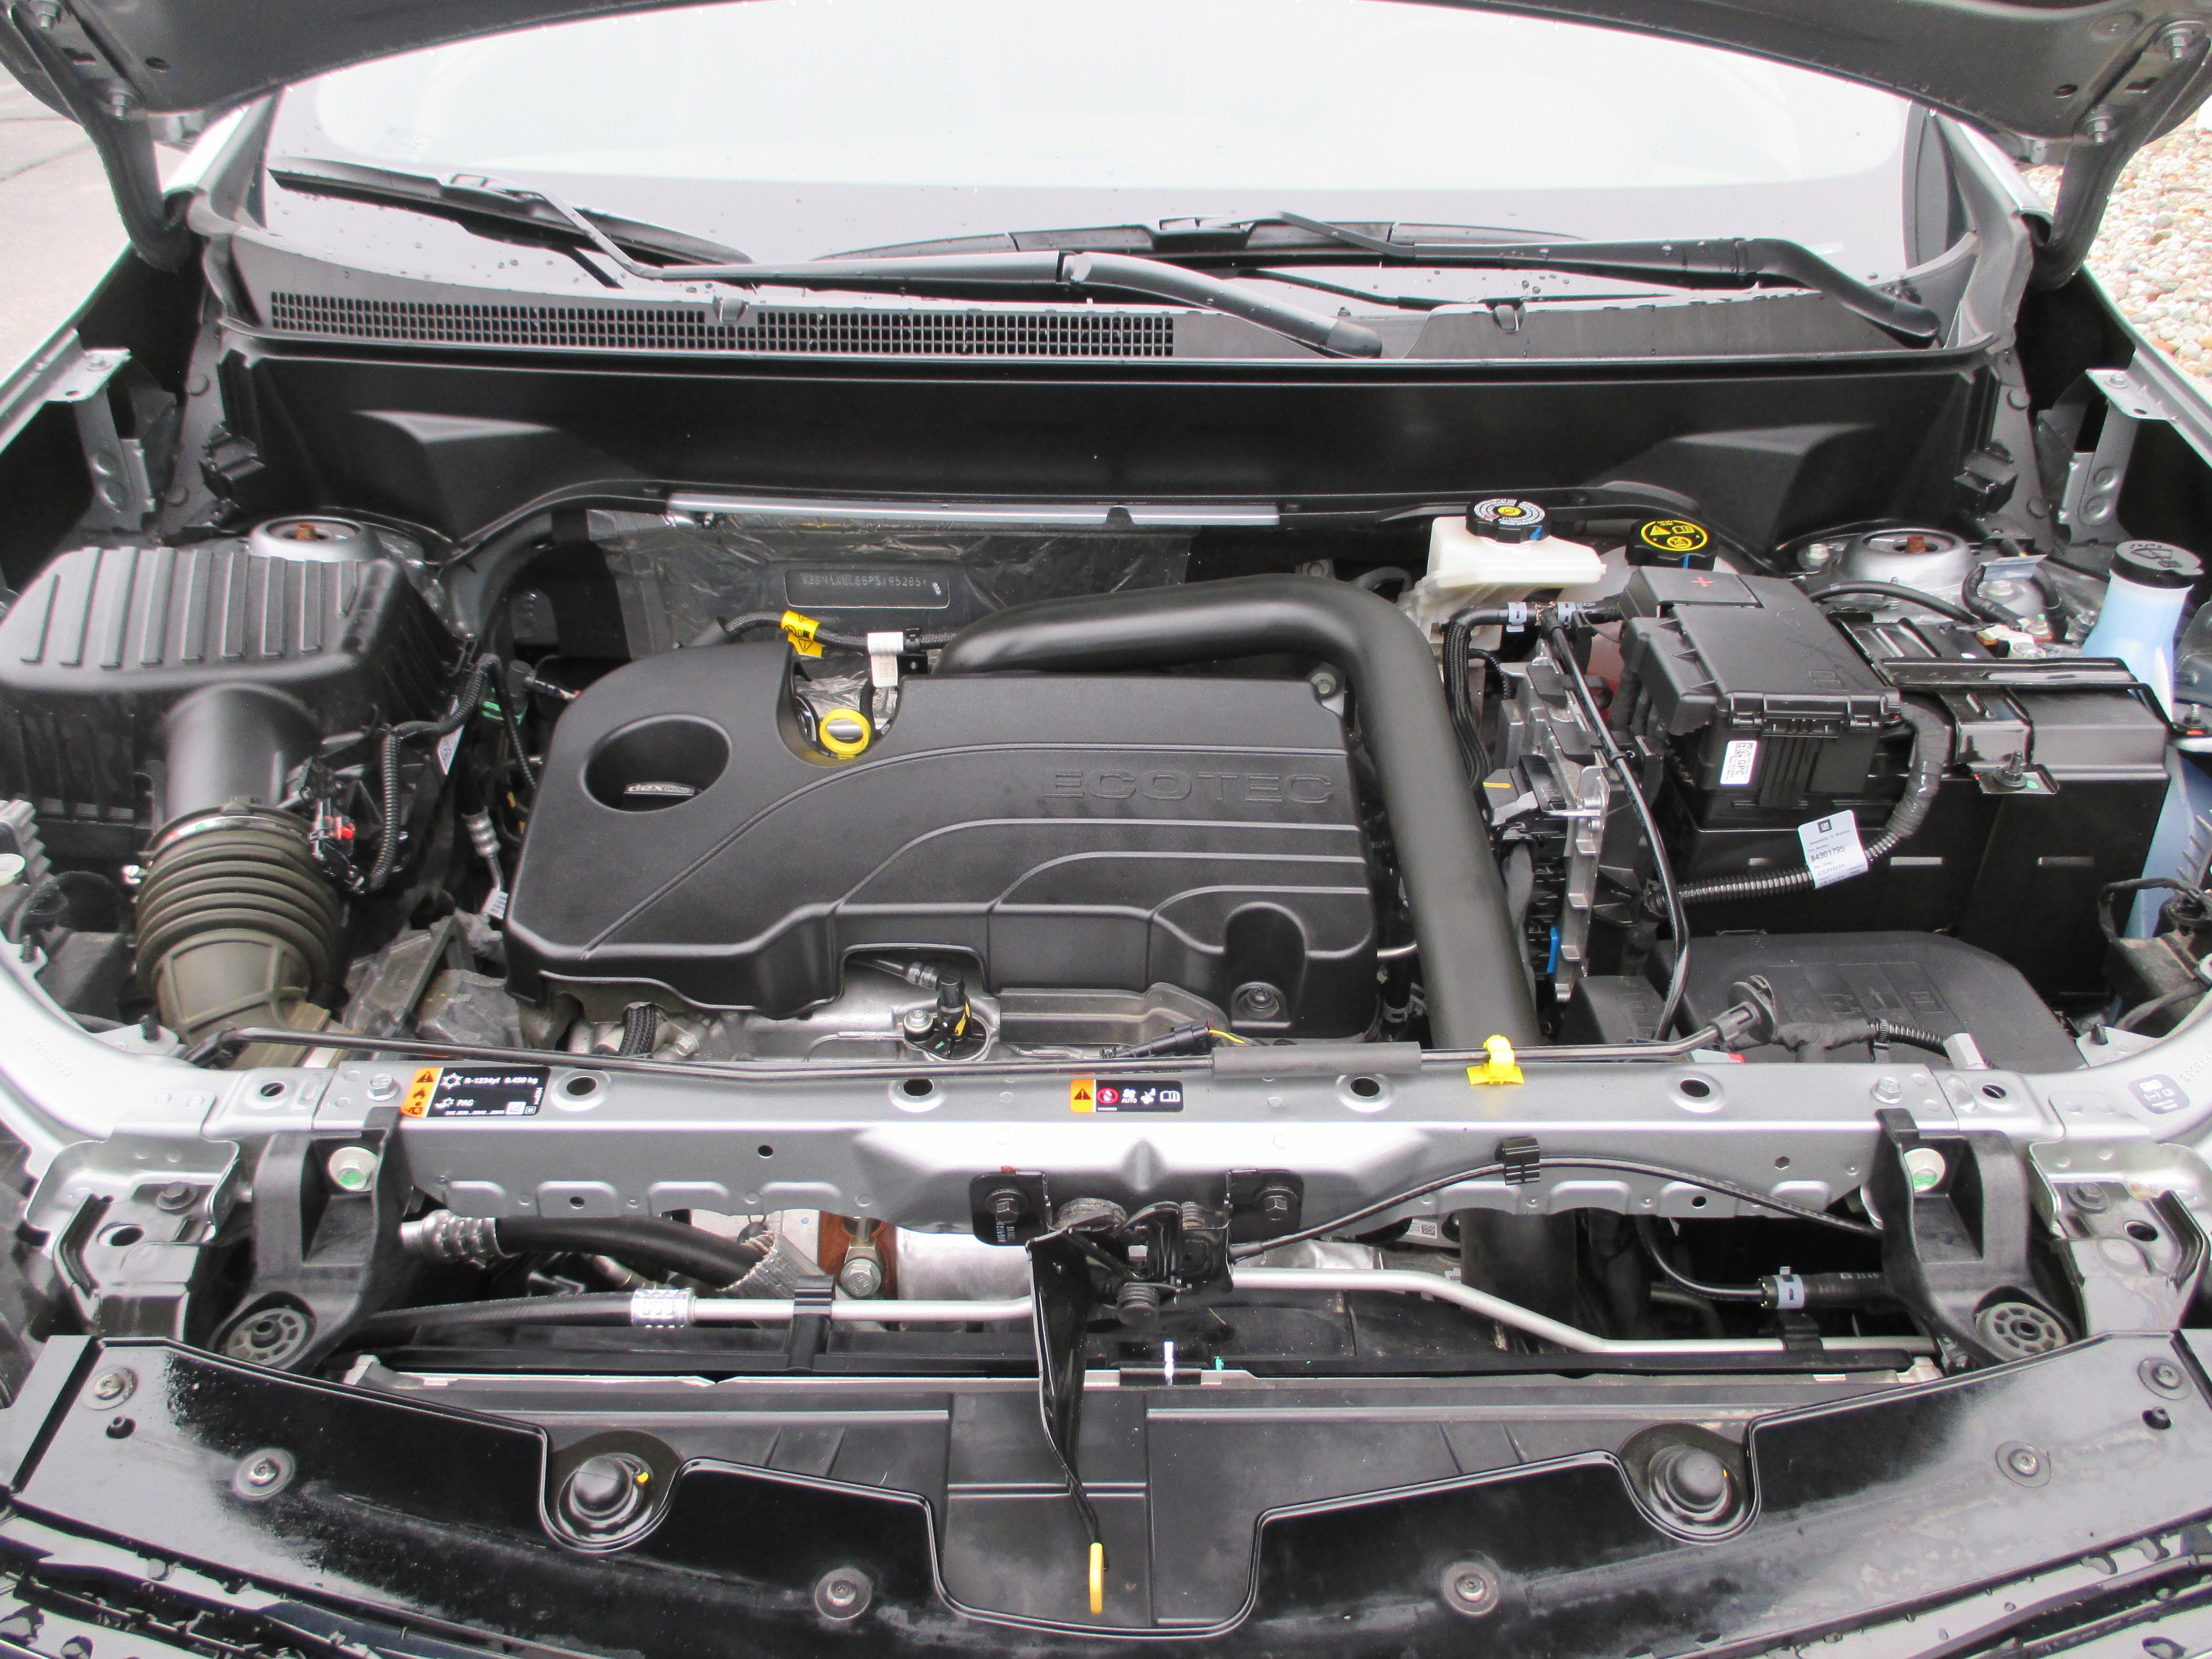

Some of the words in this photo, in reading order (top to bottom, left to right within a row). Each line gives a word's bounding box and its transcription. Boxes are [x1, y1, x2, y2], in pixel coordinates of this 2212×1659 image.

[1735, 760, 1746, 775] GPC
[628, 784, 690, 793] dexos
[1043, 769, 1334, 804] ECOTEC
[1810, 845, 1845, 862] 84301795
